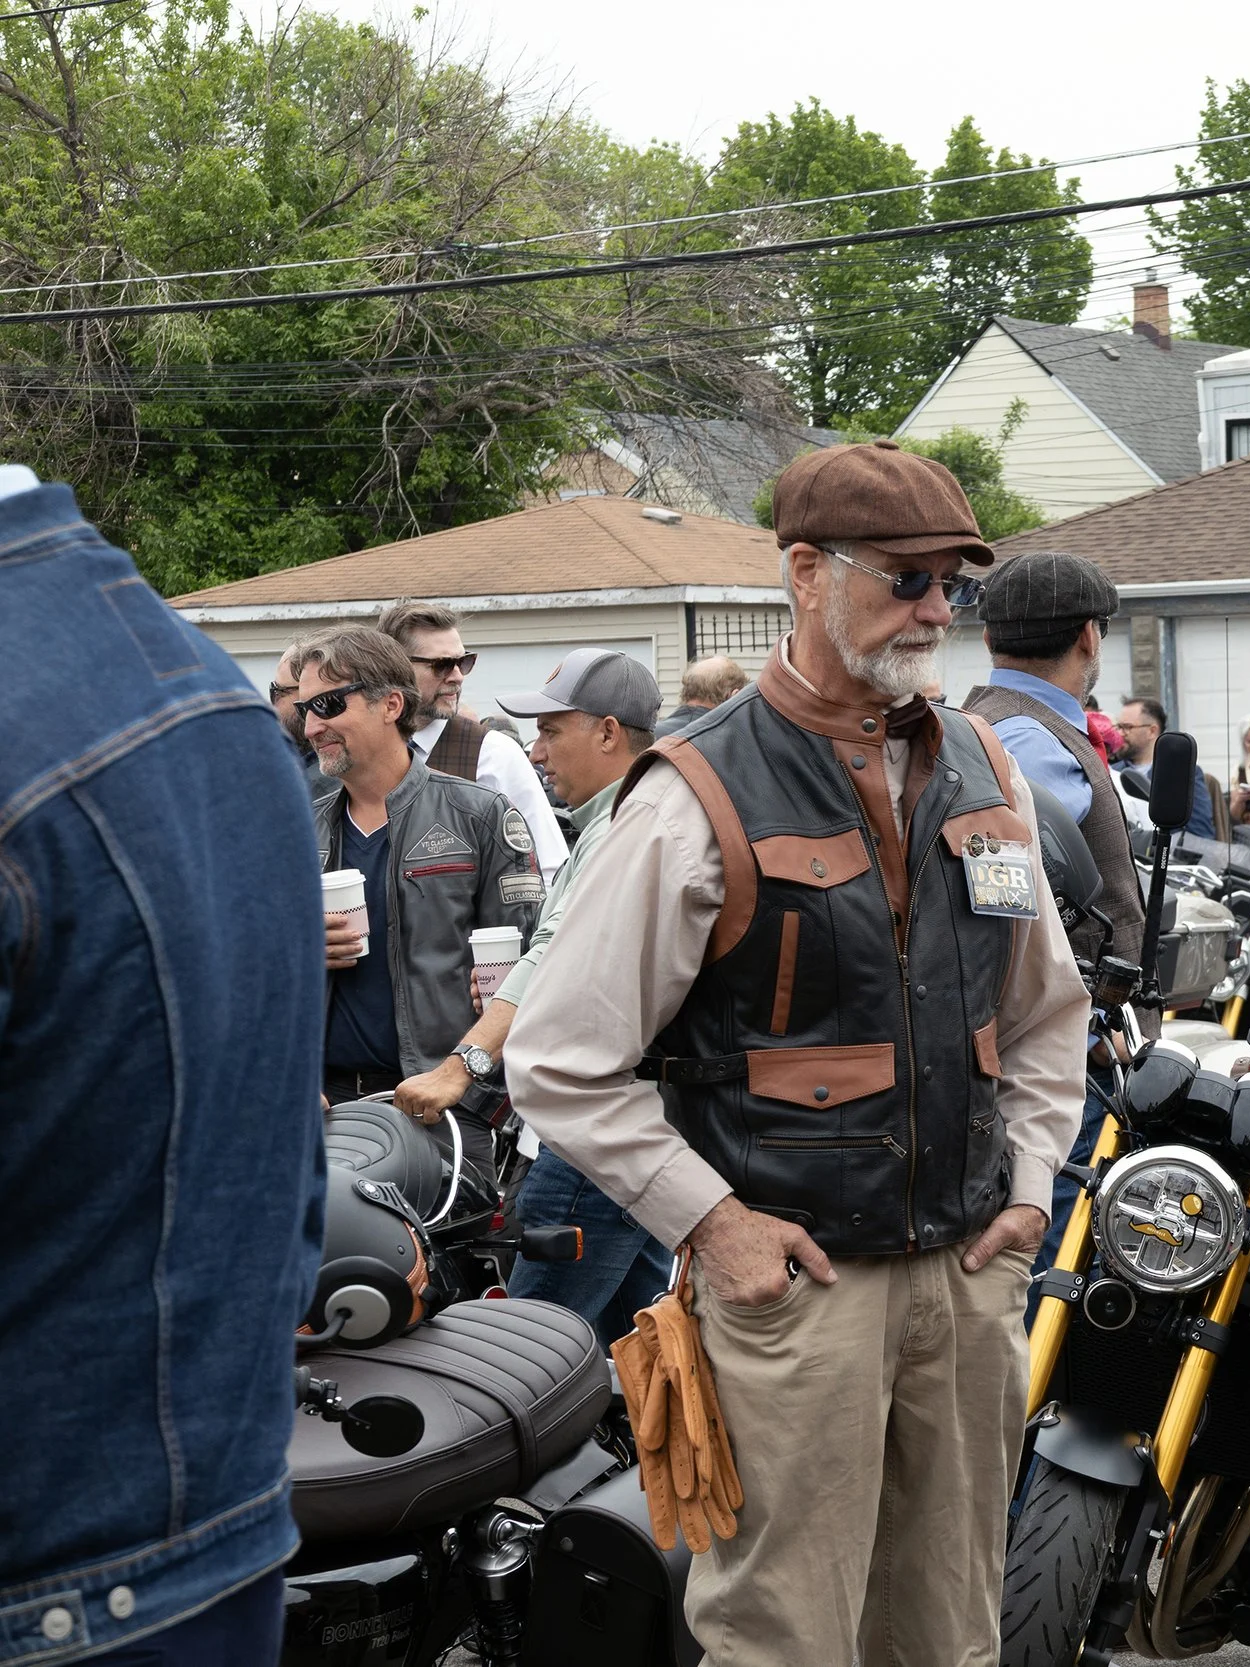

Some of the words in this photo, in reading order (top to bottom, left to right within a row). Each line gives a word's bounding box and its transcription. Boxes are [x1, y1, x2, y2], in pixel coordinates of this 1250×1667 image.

[430, 837, 455, 848] CLASSICS
[970, 865, 1029, 889] DGR
[322, 1602, 414, 1645] BONNEVILLE
